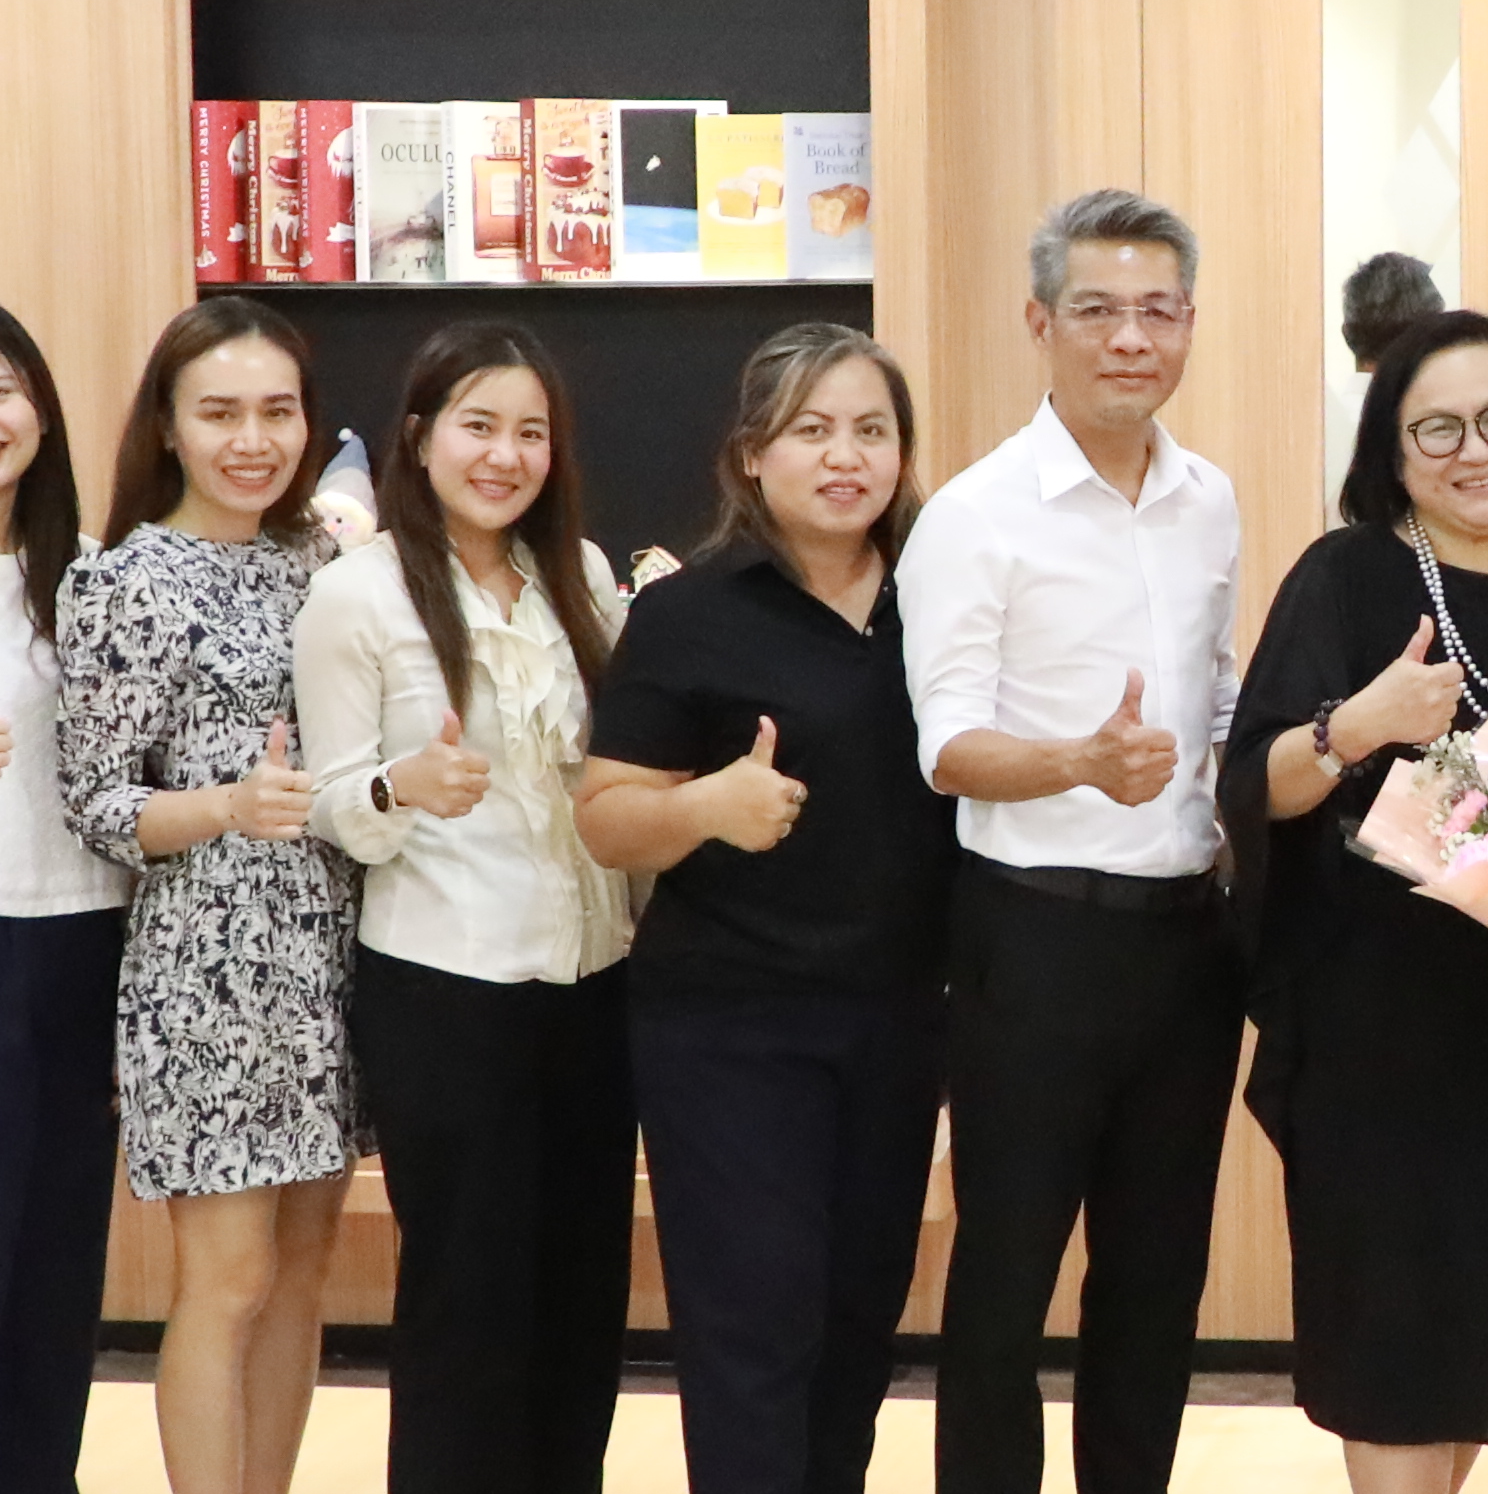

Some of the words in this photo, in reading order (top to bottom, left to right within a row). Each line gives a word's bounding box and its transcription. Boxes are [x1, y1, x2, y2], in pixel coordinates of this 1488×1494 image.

[198, 107, 209, 156] MERRY
[247, 120, 257, 171] Merry
[300, 107, 308, 156] MERRY
[522, 118, 532, 170] Merry
[807, 142, 846, 158] Book
[850, 142, 868, 157] of
[445, 151, 456, 235] CHANEL
[814, 160, 860, 175] Bread
[199, 160, 210, 237] CHRISTMAS
[248, 176, 259, 264] Christmas
[301, 160, 309, 237] CHRISTMAS
[523, 174, 533, 263] Christmas
